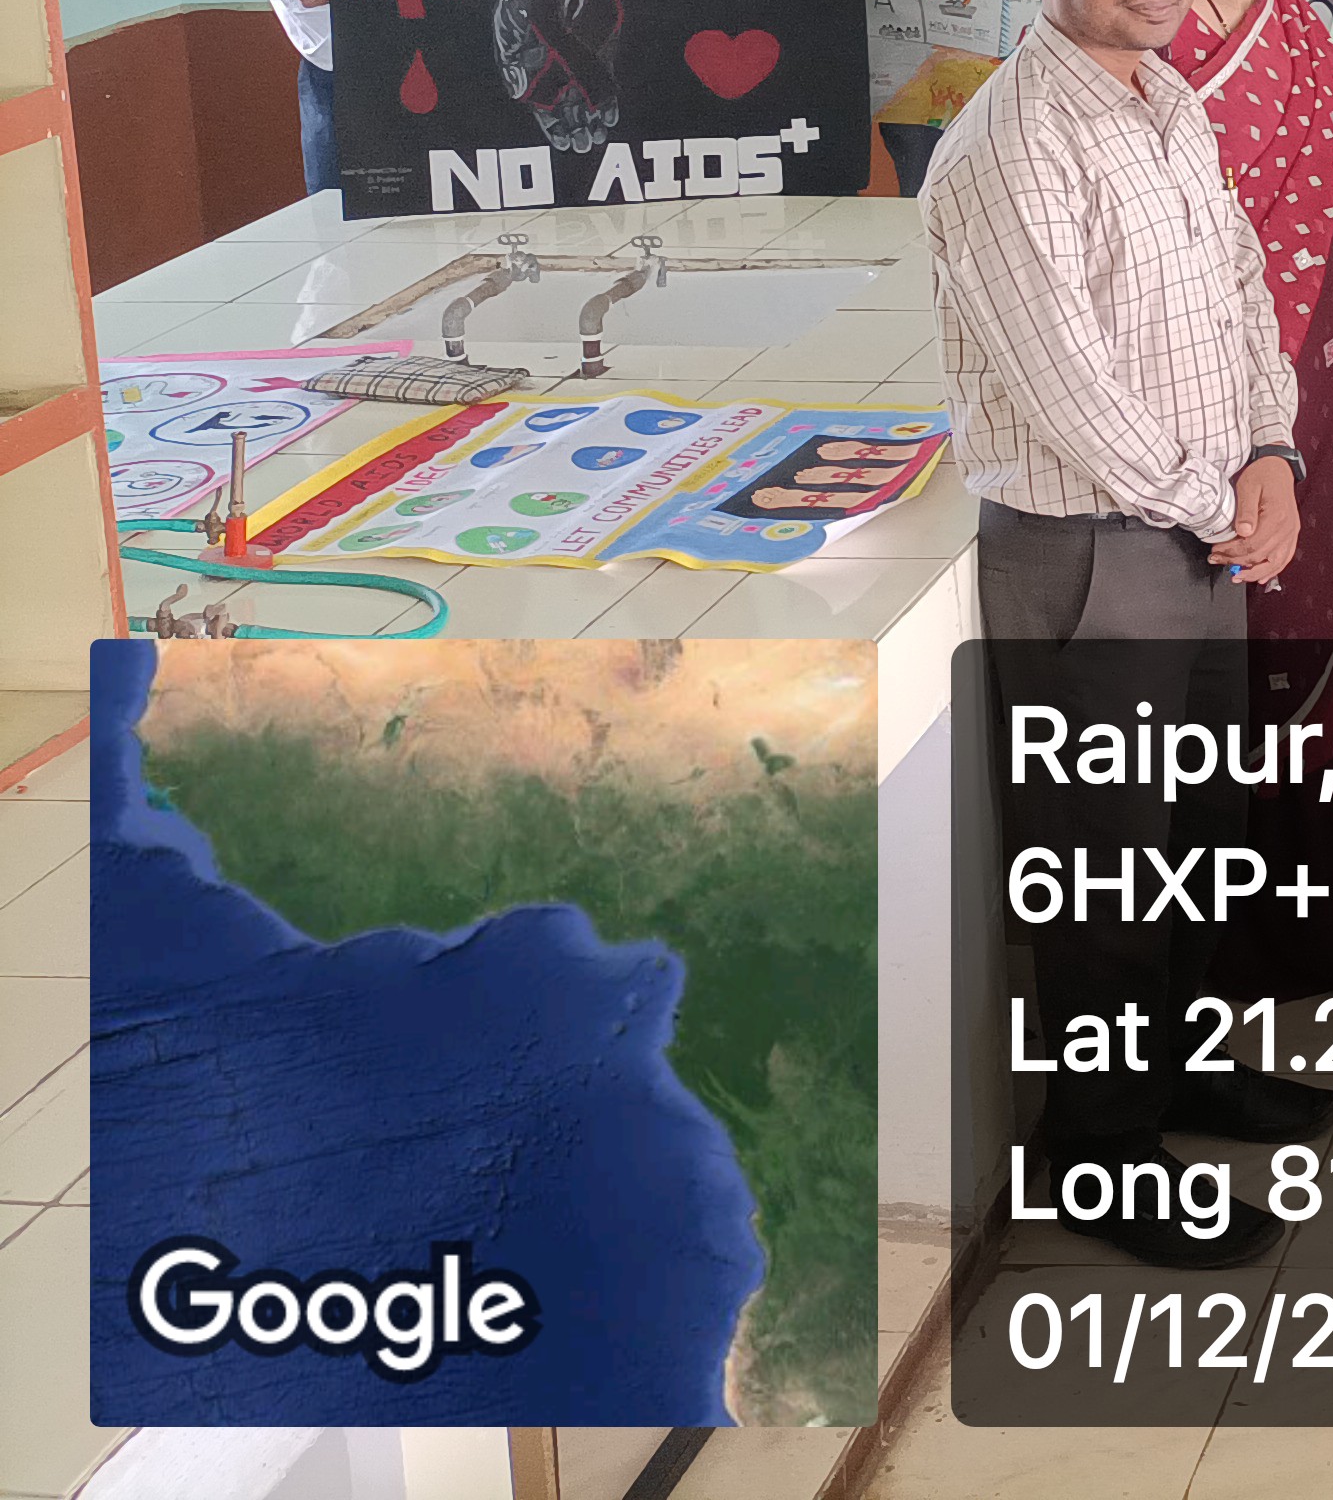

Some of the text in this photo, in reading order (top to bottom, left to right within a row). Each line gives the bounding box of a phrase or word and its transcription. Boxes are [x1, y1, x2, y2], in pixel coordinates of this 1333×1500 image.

[428, 145, 555, 211] NO
[351, 453, 418, 490] AIDS
[553, 407, 763, 553] LET COMMUNITIES LEAD
